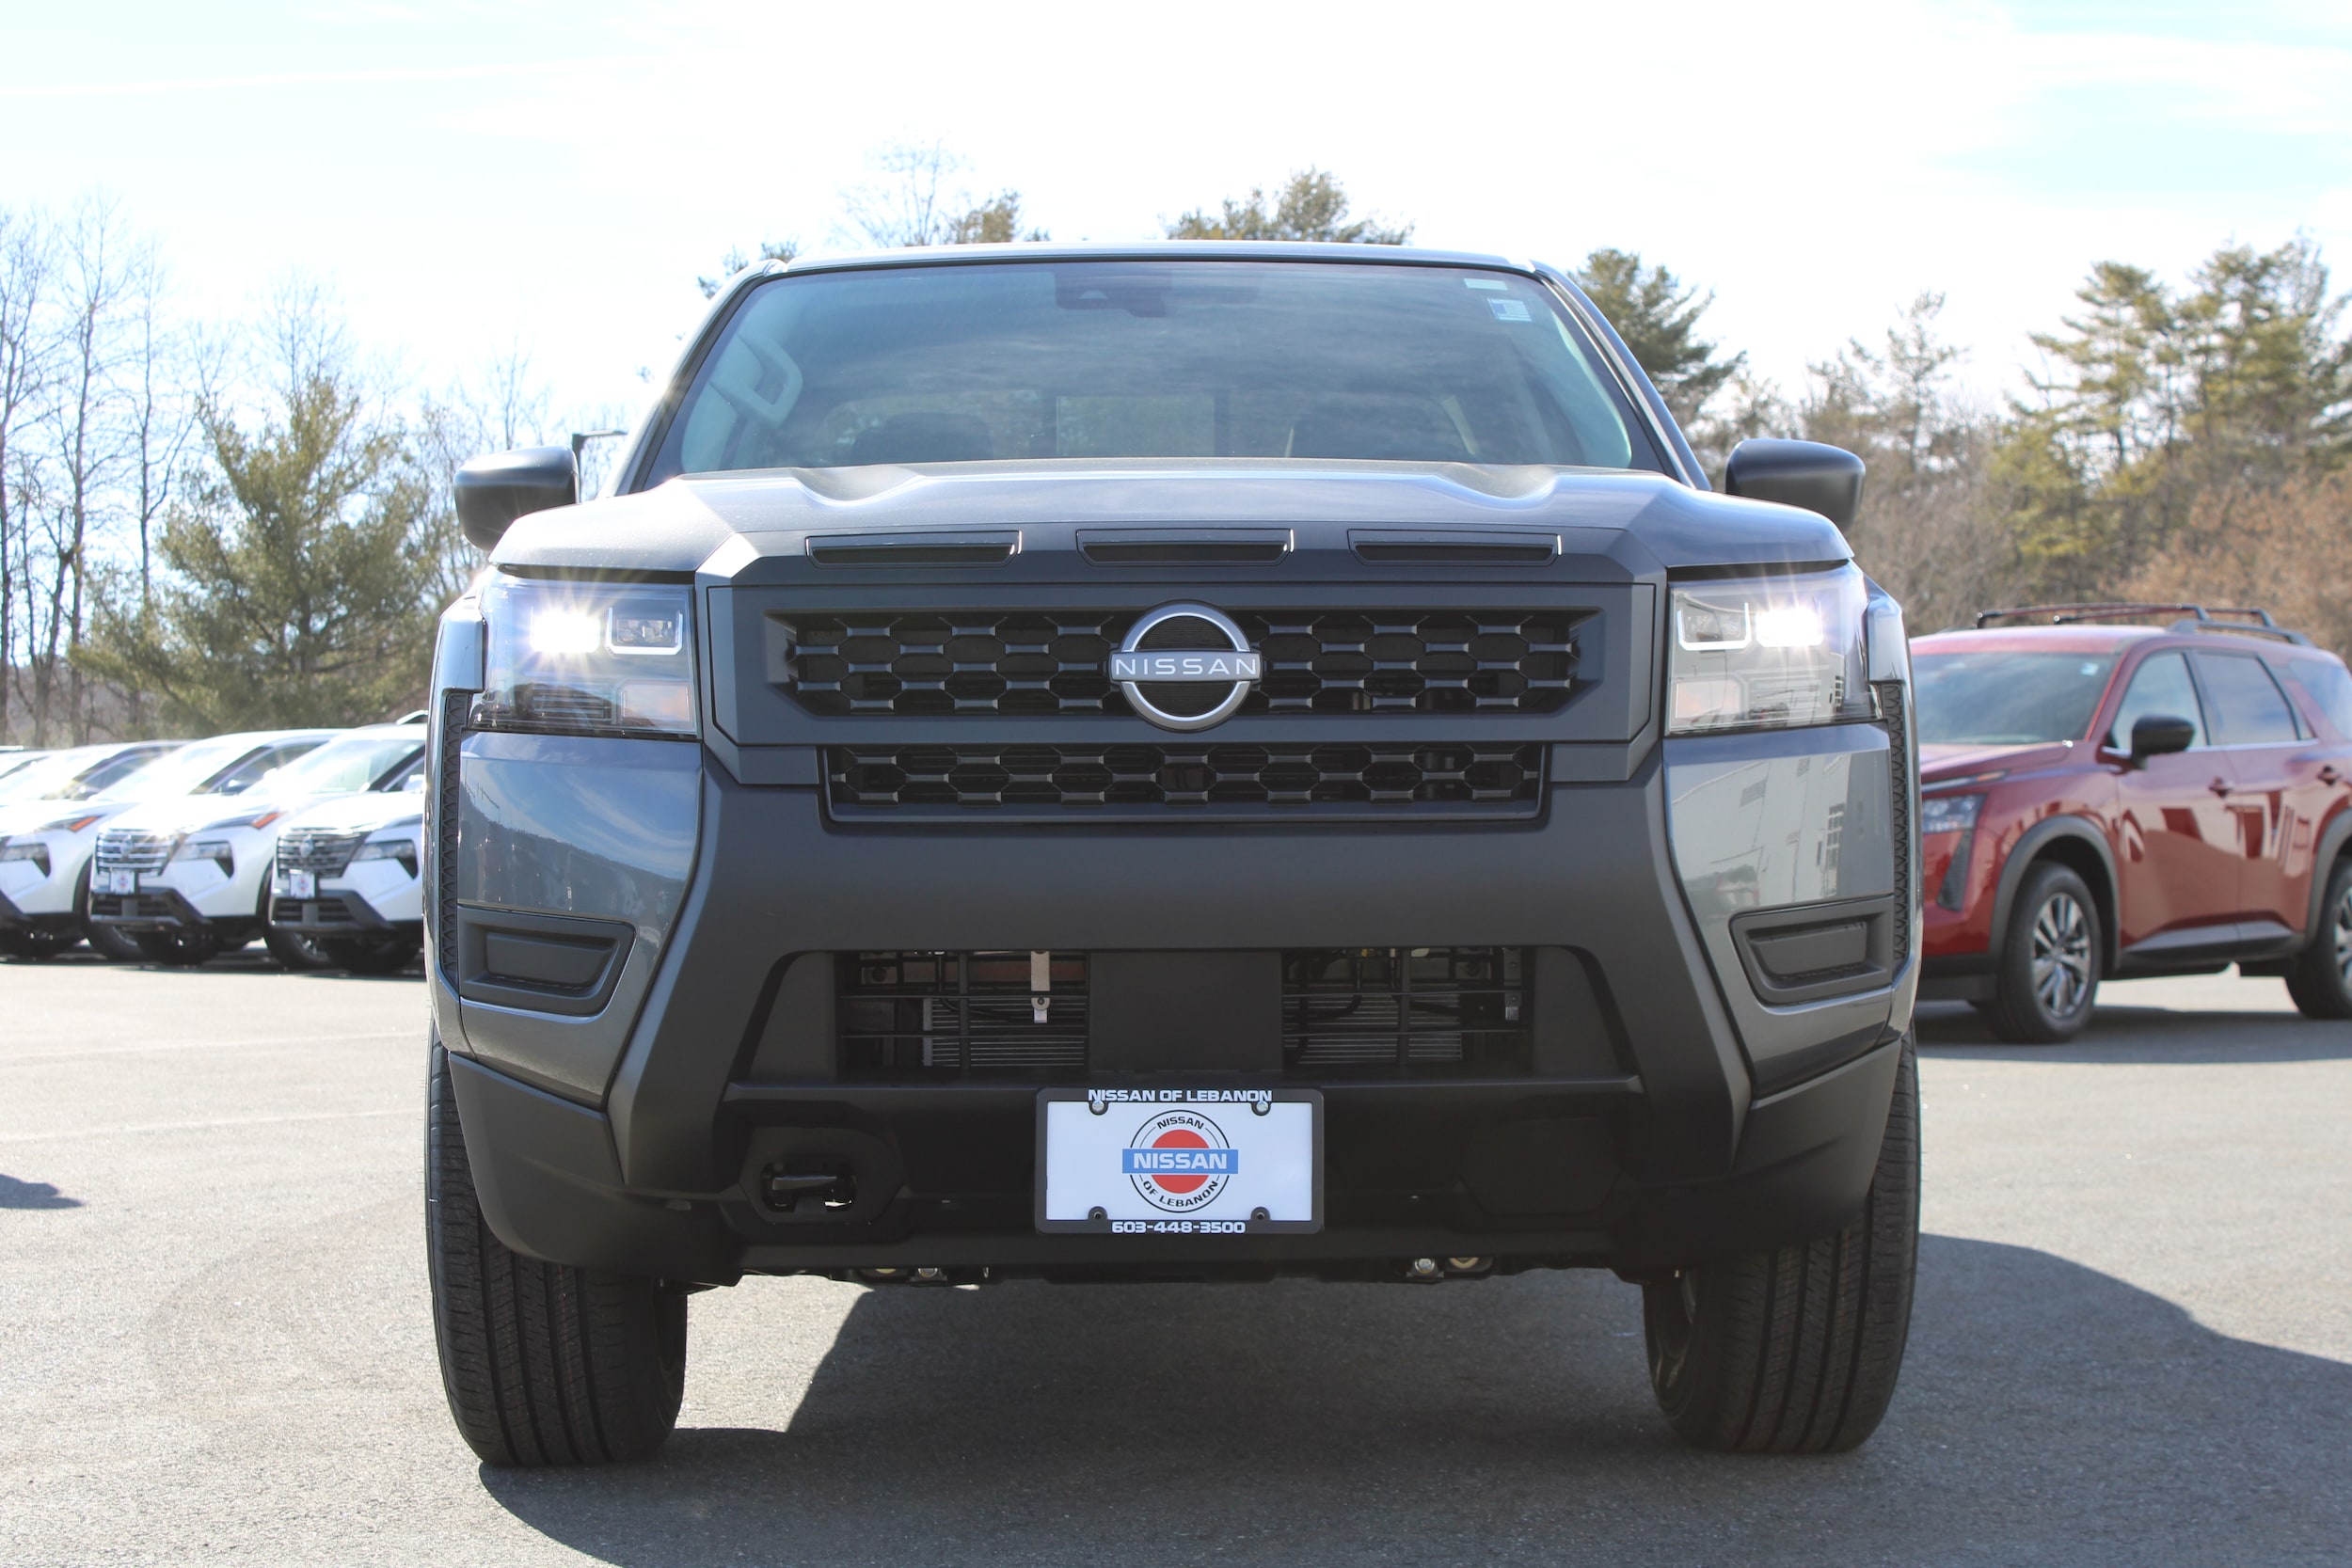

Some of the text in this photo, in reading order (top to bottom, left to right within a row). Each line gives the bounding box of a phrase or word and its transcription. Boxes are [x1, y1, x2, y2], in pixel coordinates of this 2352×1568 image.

[1115, 658, 1256, 675] NISSAN
[1088, 1089, 1272, 1102] NISSAN OF LEBANON
[1156, 1116, 1205, 1130] NISSAN
[1133, 1152, 1228, 1170] NISSAN
[1142, 1180, 1219, 1208] OF LEBANON
[1111, 1221, 1247, 1234] 603-448-3500
